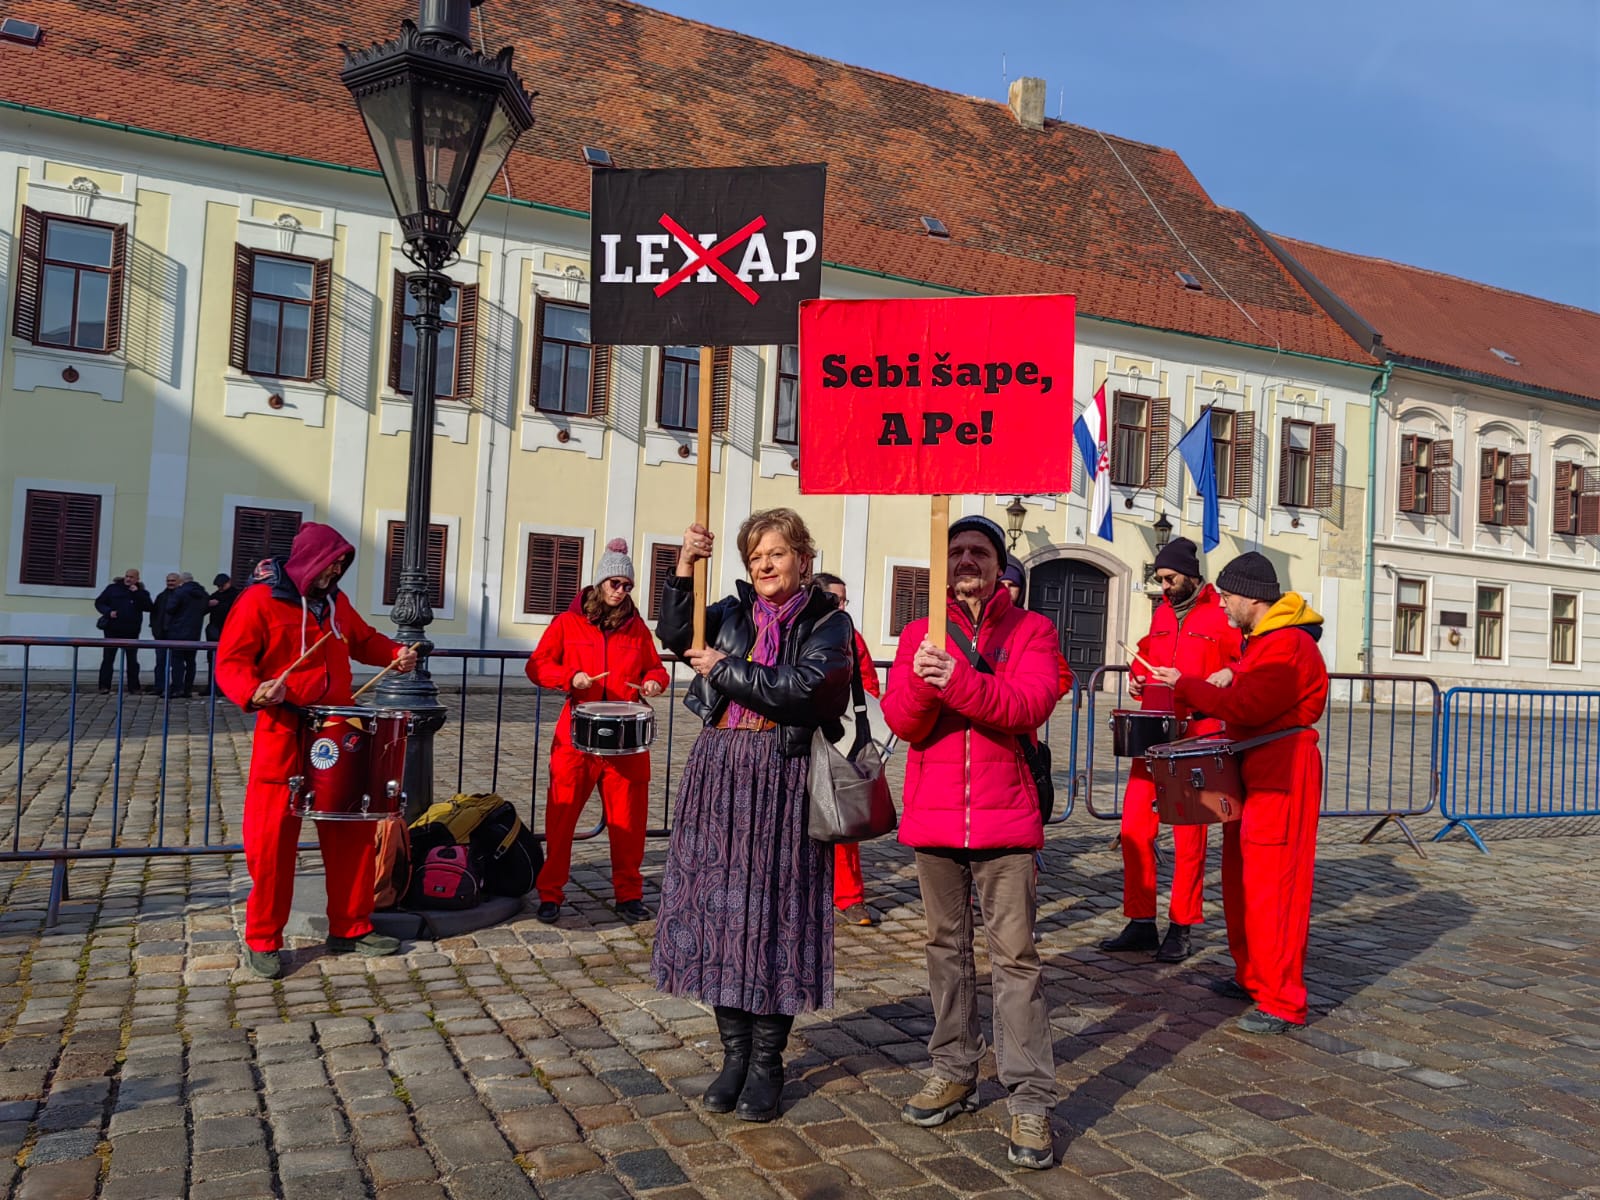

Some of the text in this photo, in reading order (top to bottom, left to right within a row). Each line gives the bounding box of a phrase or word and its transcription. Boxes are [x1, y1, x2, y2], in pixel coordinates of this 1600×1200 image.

[600, 229, 817, 283] LEX AP
[822, 352, 1053, 394] Sebi šape,
[877, 410, 994, 446] A Pe!
